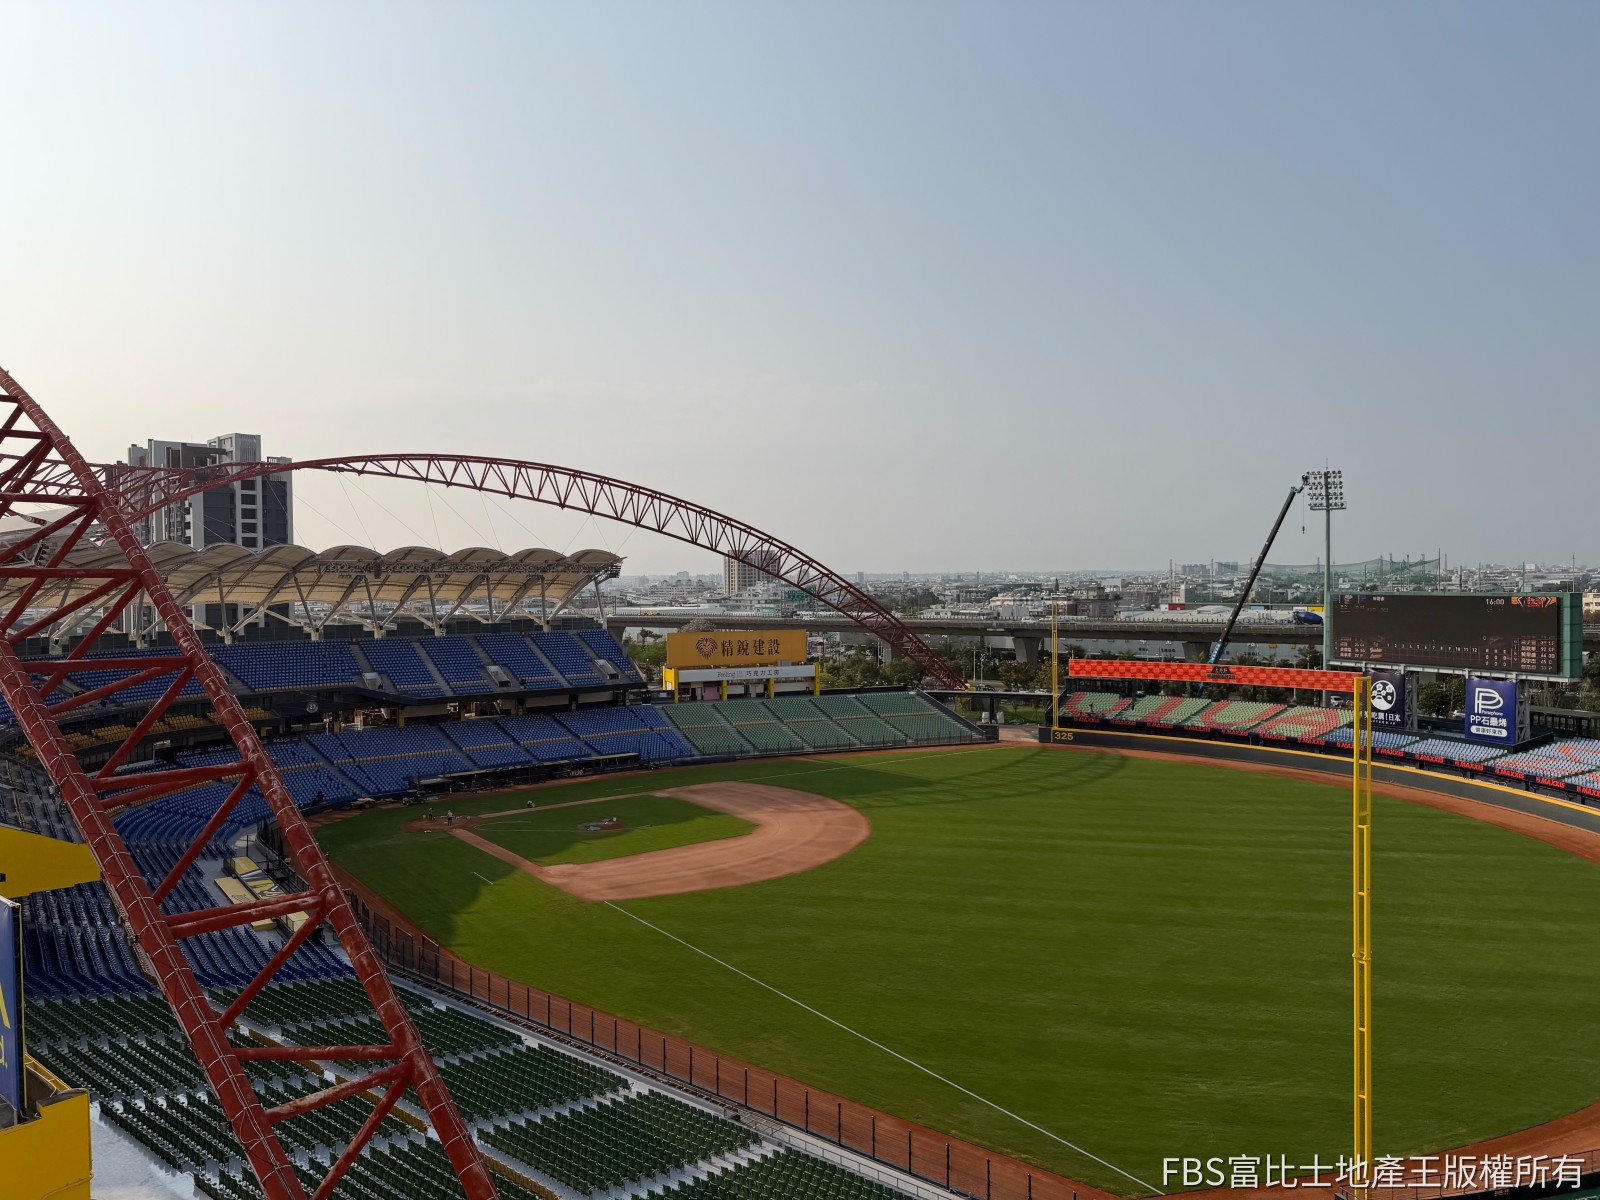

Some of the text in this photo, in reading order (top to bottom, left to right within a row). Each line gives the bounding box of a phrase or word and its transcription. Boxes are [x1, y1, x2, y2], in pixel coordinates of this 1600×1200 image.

[721, 639, 781, 657] 精銳建設
[746, 669, 780, 677] 巧克力工房
[1470, 714, 1507, 728] PP石墨烯
[1054, 731, 1074, 741] 325
[1302, 738, 1326, 746] MAXXIS
[1381, 748, 1404, 757] MAXXIS
[1420, 754, 1444, 764] MAXXIS
[1460, 761, 1484, 771] MAXXIS
[1500, 769, 1524, 779] MAXXIS
[1541, 777, 1565, 789] MAXXIS
